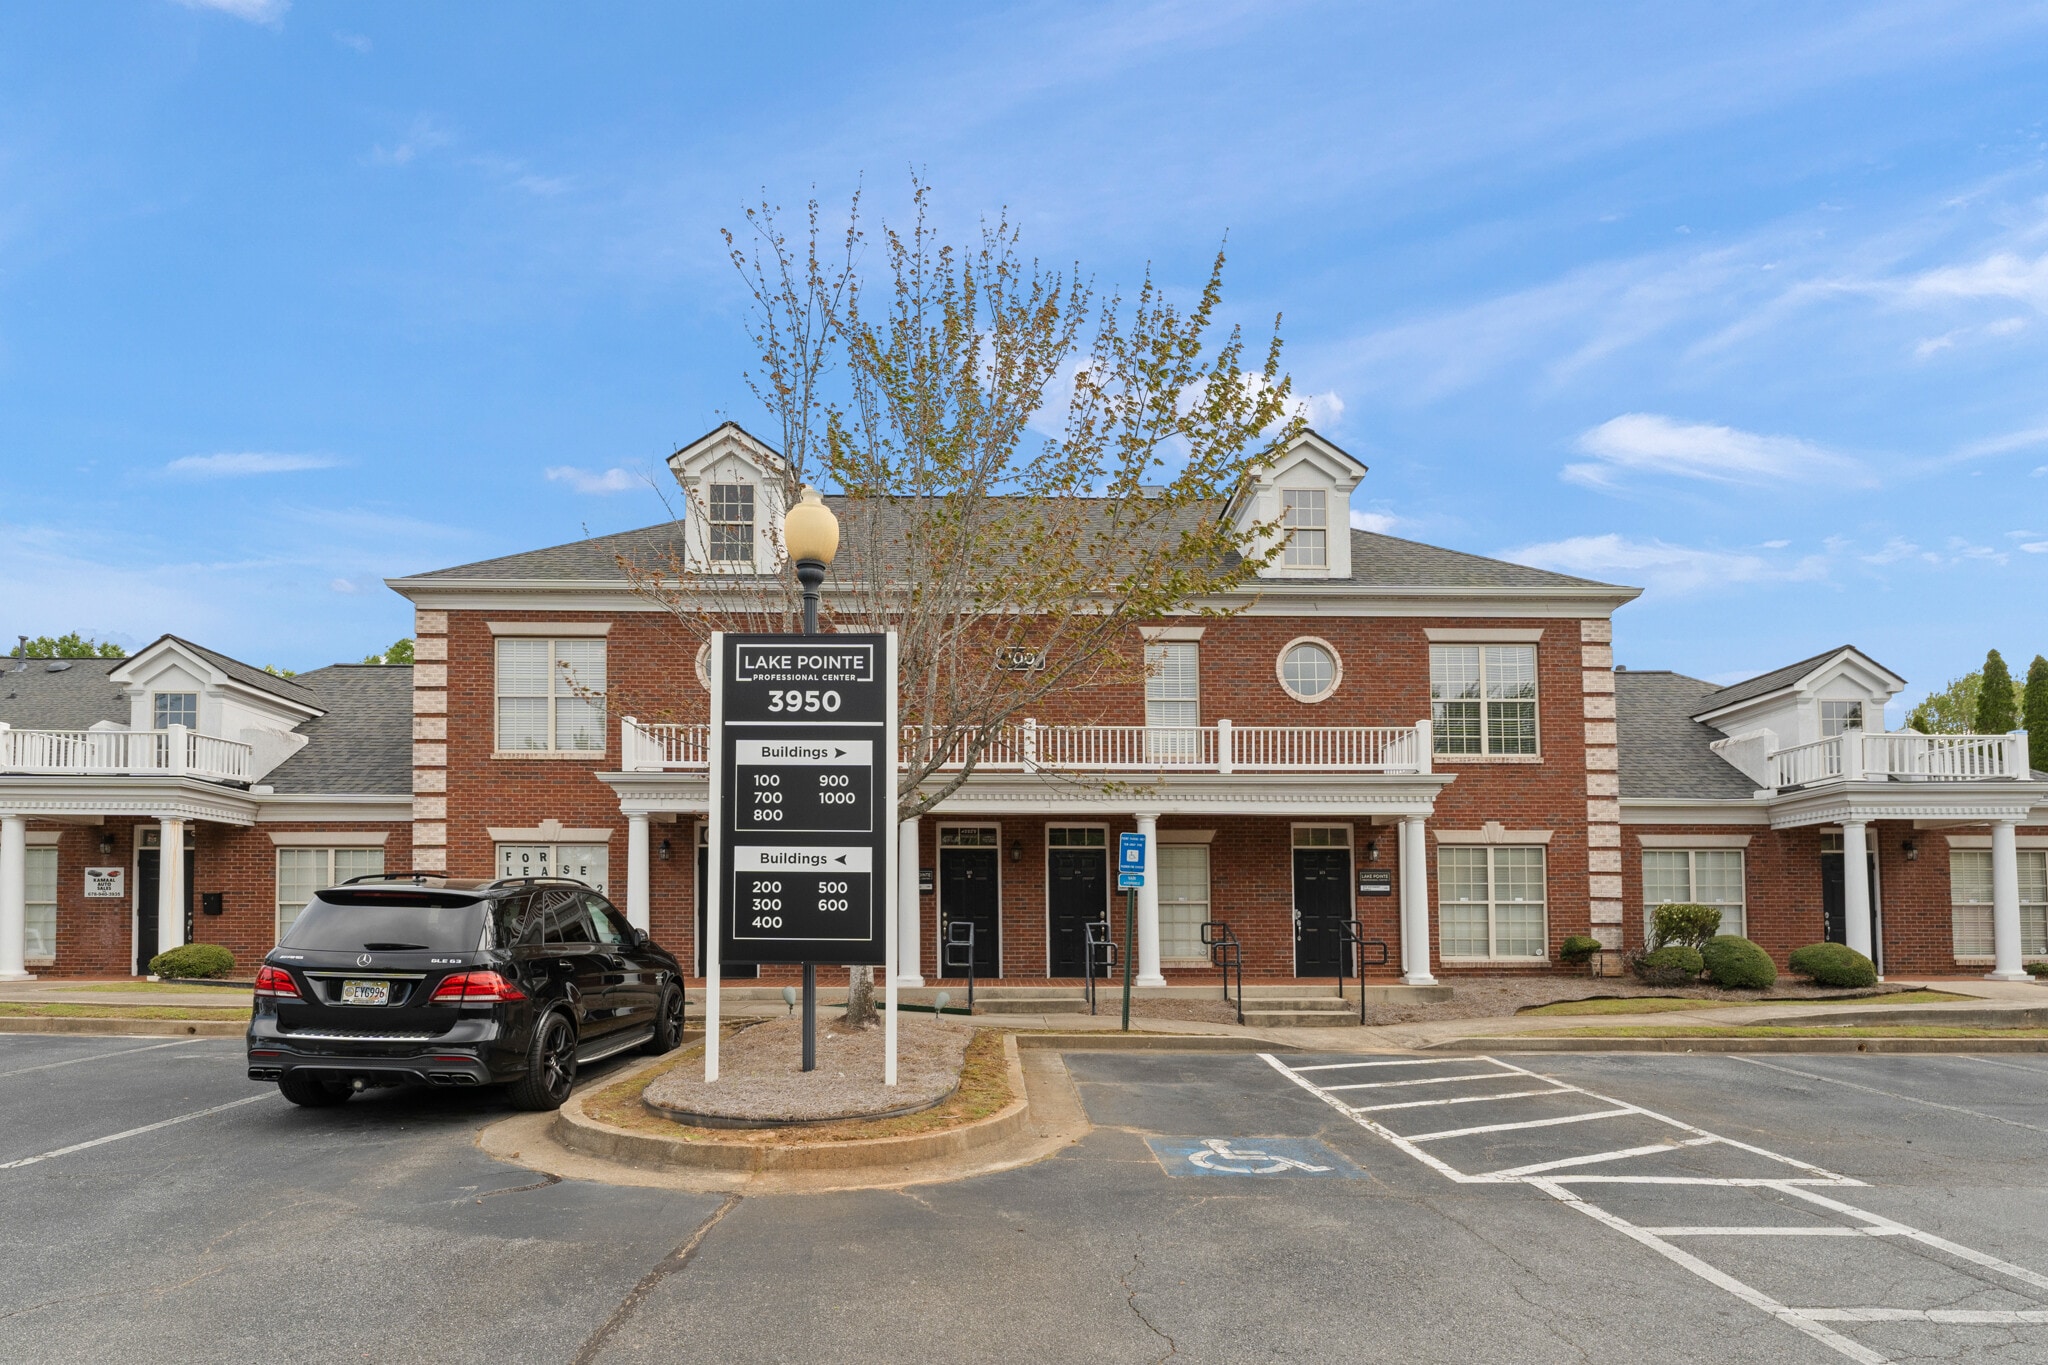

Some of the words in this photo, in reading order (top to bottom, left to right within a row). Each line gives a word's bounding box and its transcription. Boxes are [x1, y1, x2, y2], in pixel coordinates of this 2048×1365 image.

[744, 655, 792, 670] LAKE
[797, 655, 864, 670] POINTE
[753, 673, 819, 681] PROFESSIONAL
[821, 673, 856, 681] CENTER
[767, 689, 842, 713] 3950
[761, 746, 828, 760] Buildings
[753, 774, 780, 787] 100
[819, 774, 850, 787] 900
[753, 791, 783, 804] 700
[818, 792, 856, 805] 1000
[753, 809, 783, 822] 800
[506, 852, 547, 862] FOR
[760, 852, 828, 867] Buildings
[506, 865, 587, 876] LEASE
[752, 881, 782, 894] 200
[818, 881, 848, 894] 500
[752, 899, 782, 911] 300
[818, 899, 848, 912] 600
[752, 916, 783, 929] 400
